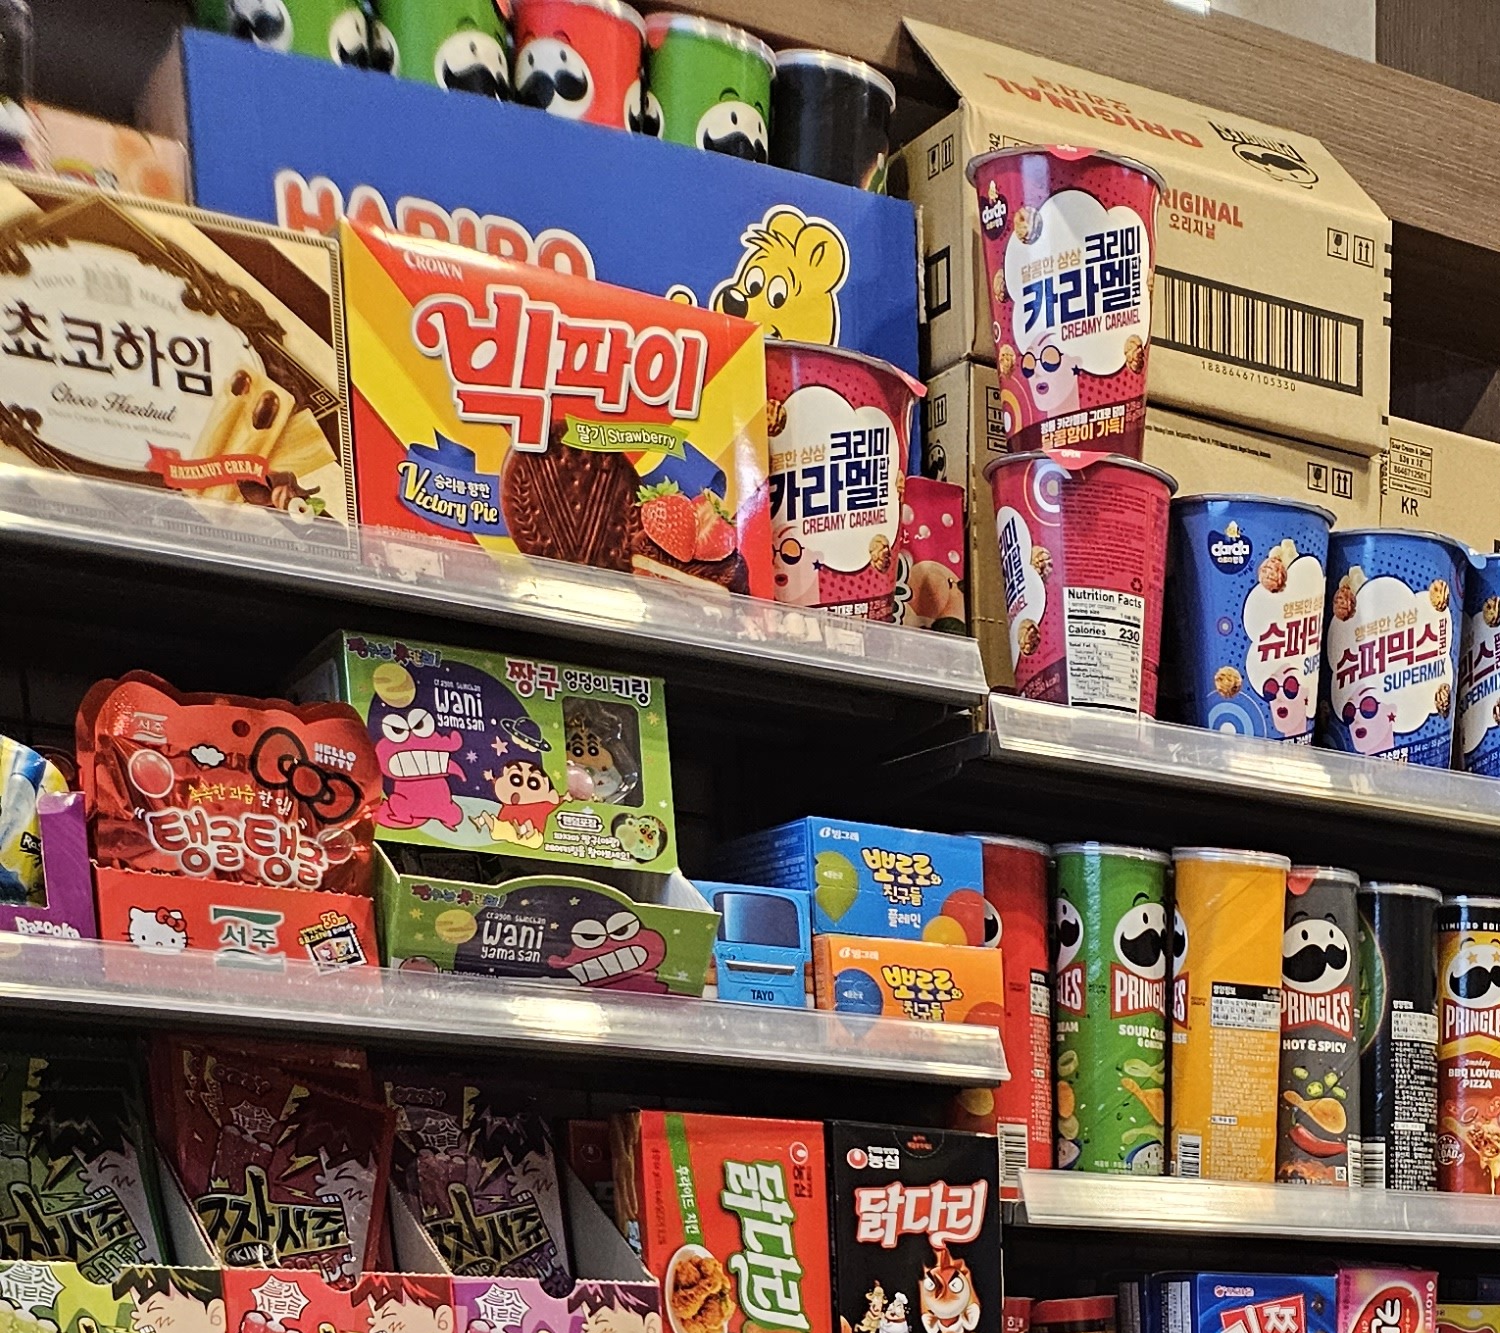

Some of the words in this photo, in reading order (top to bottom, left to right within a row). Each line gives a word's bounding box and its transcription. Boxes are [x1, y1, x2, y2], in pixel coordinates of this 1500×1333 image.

[1168, 213, 1217, 240] 오리지널
[1085, 226, 1142, 264] 크리미
[402, 249, 465, 283] CROWN
[1057, 249, 1081, 268] 상상
[1022, 260, 1132, 334] 카라멜
[1061, 315, 1103, 342] CREAMY
[1105, 309, 1142, 331] CARAMEL
[411, 284, 709, 453] 빅파이
[51, 380, 99, 409] Choco
[102, 390, 178, 423] Hazelnut
[576, 424, 601, 445] 딸기
[607, 428, 676, 450] Strawberry
[830, 426, 890, 473] 크리미
[168, 461, 223, 480] HAZELNUT
[225, 458, 265, 479] CREAM
[398, 460, 467, 526] Victory
[471, 500, 499, 524] Pie
[1400, 496, 1421, 517] KR
[802, 513, 846, 536] CREAMY
[848, 508, 888, 530] CARAMEL
[1211, 541, 1251, 557] darda
[1067, 587, 1116, 605] Nutrition
[1117, 593, 1142, 609] Facts
[1068, 624, 1107, 637] Calories
[1119, 627, 1140, 642] 230
[1355, 615, 1392, 642] 행복한
[1395, 608, 1419, 628] 상상
[1337, 627, 1440, 688] 슈퍼믹스
[506, 656, 563, 700] 짱구
[564, 670, 609, 692] 엉덩이
[610, 678, 651, 707] 키링
[1383, 658, 1447, 694] SUPERMIX
[314, 742, 357, 763] HELLO
[314, 753, 356, 772] KITTY
[831, 828, 860, 842] 빙그레
[882, 884, 924, 907] 친구들
[16, 915, 81, 939] Bazooka
[887, 907, 921, 929] 플레인
[1440, 921, 1479, 932] LIMITED
[221, 921, 277, 950] 서주
[750, 988, 775, 1003] TAYO
[903, 1000, 945, 1022] 친구들
[1281, 989, 1353, 1036] PRINGLES
[1118, 1023, 1149, 1037] SOUR
[1282, 1038, 1306, 1053] HOT
[1319, 1039, 1347, 1055] SPICY
[1447, 1067, 1471, 1080] BBQ
[1461, 1079, 1493, 1090] PIZZA
[867, 1155, 900, 1170] 농심
[853, 1178, 989, 1249] 닭다리
[720, 1159, 812, 1333] 닭다리
[1425, 1292, 1434, 1331] LOTTE
